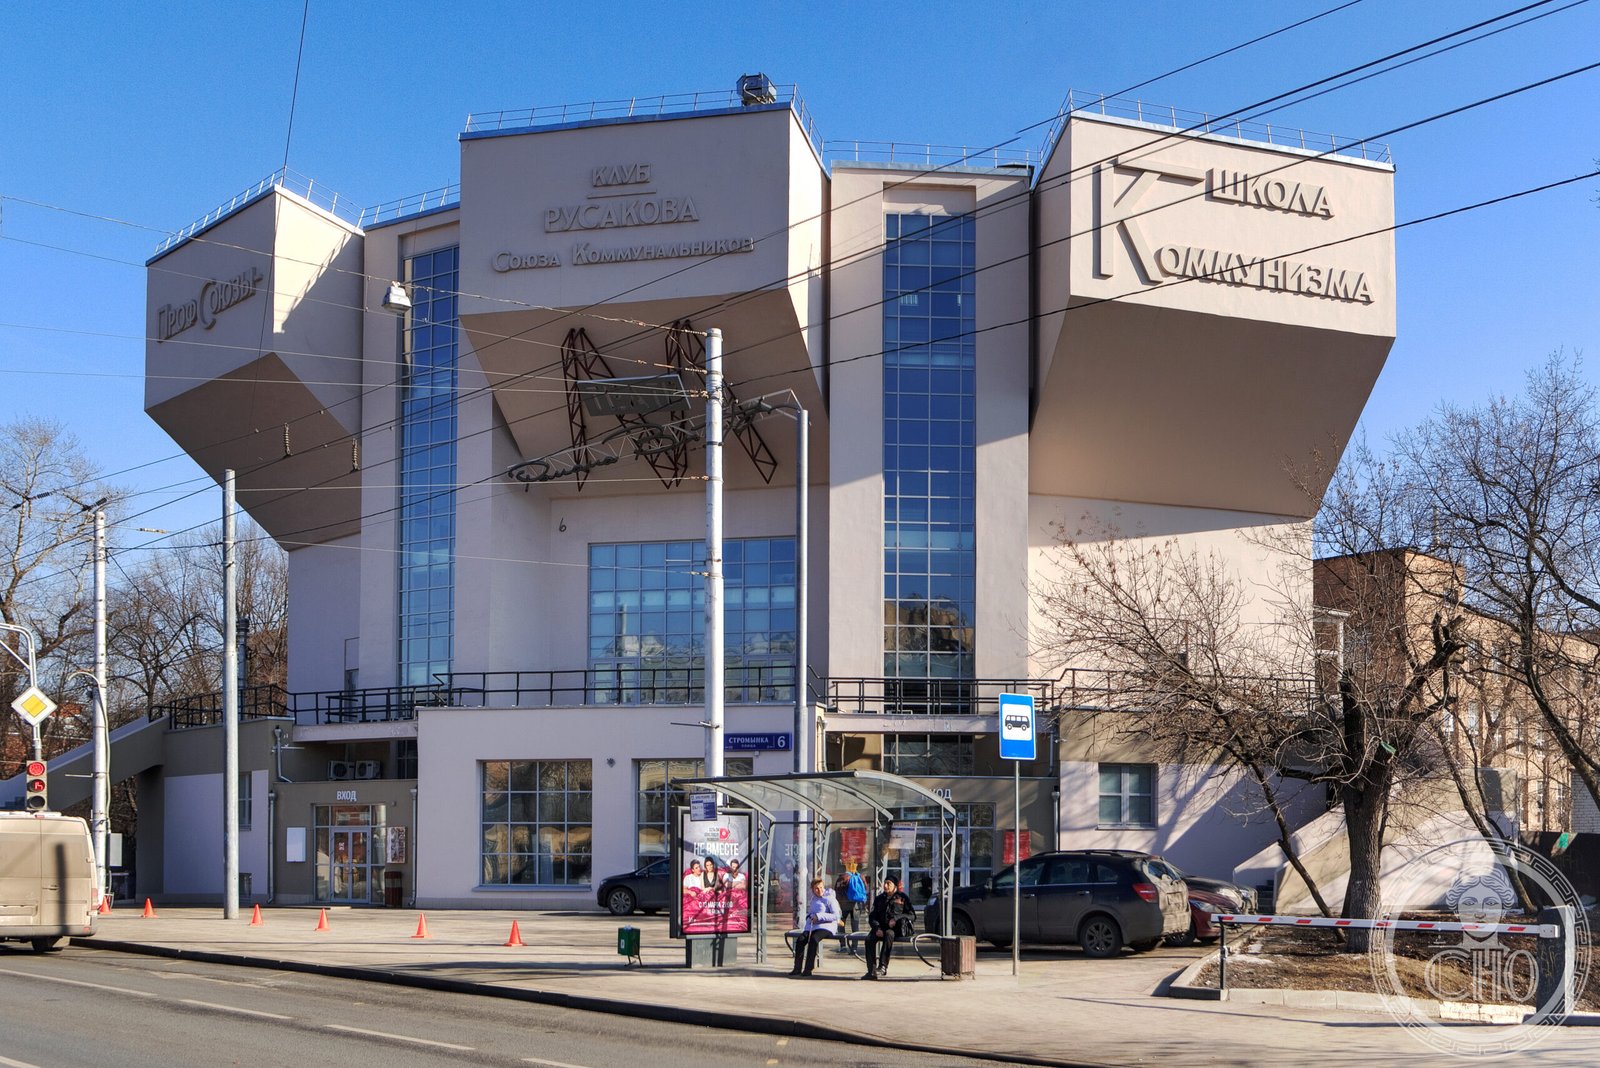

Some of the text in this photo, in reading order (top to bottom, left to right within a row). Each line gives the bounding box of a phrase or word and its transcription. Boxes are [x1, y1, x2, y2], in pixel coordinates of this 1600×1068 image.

[591, 163, 651, 187] КЛУБ
[1206, 166, 1334, 220] ШКОЛА
[544, 196, 701, 233] РУСАКОВА
[1092, 156, 1375, 306] КОММУНИЗМА
[777, 735, 786, 748] 6
[336, 790, 357, 802] ВХОД
[693, 842, 740, 856] НЕ ВМЕСТЕ
